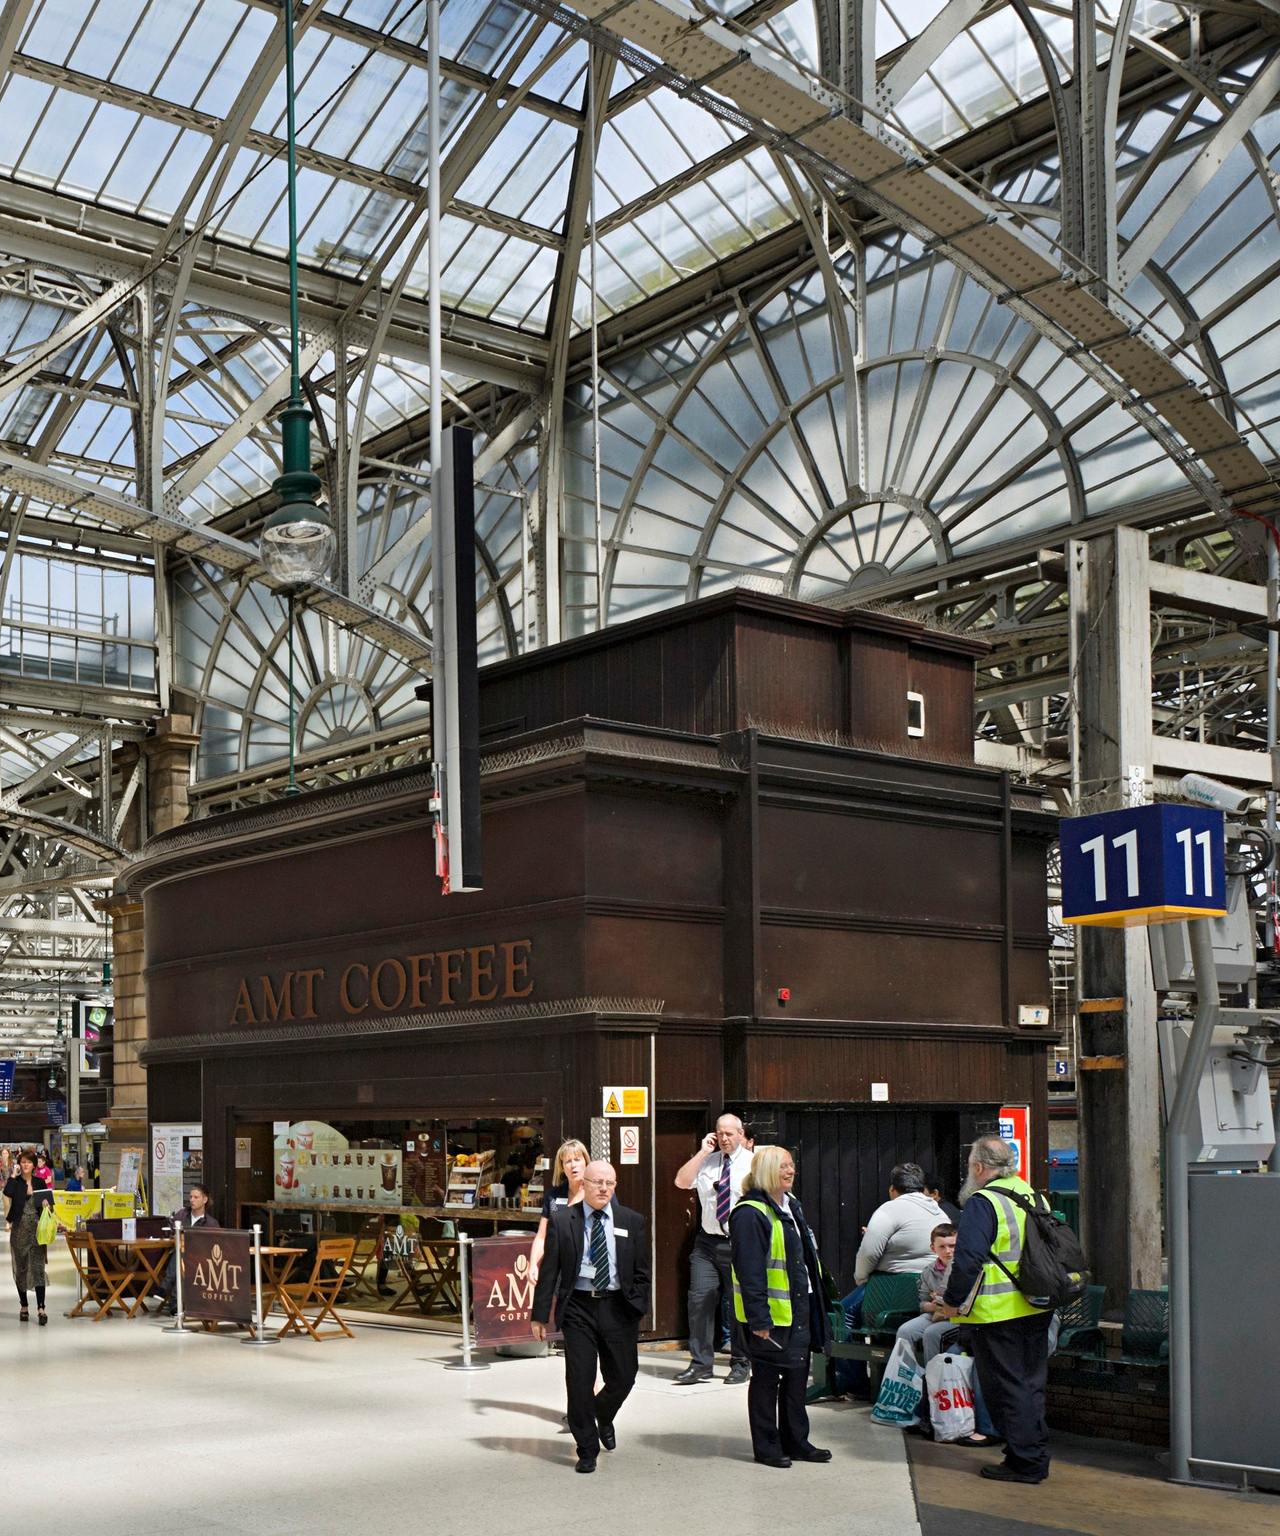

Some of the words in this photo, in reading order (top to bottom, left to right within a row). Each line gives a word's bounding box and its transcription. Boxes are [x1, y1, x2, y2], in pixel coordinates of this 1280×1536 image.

[1079, 828, 1140, 902] 11
[1175, 827, 1213, 897] 11
[229, 968, 325, 1025] AMT
[339, 939, 535, 1015] COFFEE
[1059, 1062, 1066, 1074] 5
[383, 1234, 417, 1256] AMT
[192, 1258, 242, 1293] AMT
[486, 1273, 535, 1311] AM
[201, 1292, 235, 1302] COFFEE
[500, 1311, 529, 1321] COFF
